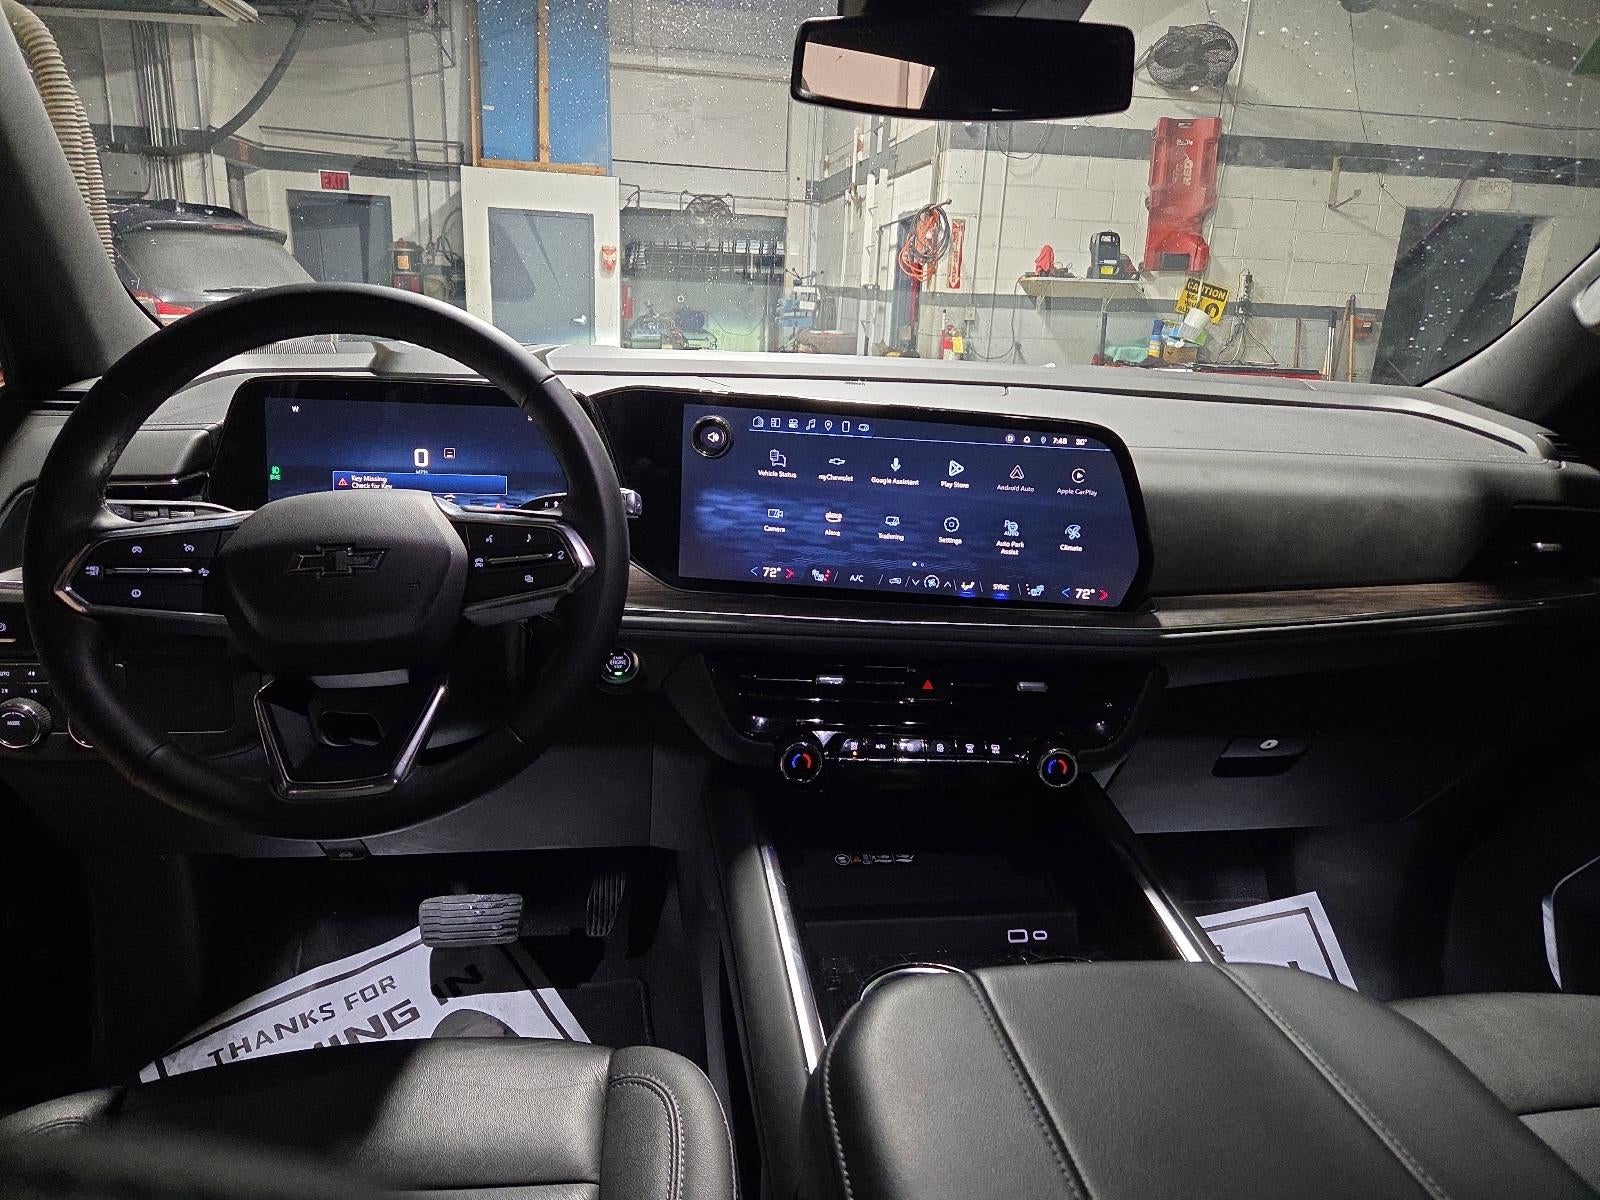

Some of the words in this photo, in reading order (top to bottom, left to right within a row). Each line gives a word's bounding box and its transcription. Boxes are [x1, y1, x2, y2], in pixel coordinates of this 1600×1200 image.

[322, 172, 348, 189] EXIT
[414, 448, 429, 467] 0
[757, 469, 778, 477] Vehicle
[778, 470, 797, 478] Status
[818, 473, 854, 482] myChevrolet
[351, 474, 363, 482] Key
[363, 475, 387, 483] Missing
[870, 476, 892, 485] Google
[892, 478, 920, 486] Assistant
[940, 480, 953, 489] Play
[953, 481, 970, 489] Store
[996, 484, 1020, 492] Android
[1020, 485, 1035, 493] Auto
[1056, 487, 1075, 495] Apple
[1074, 488, 1098, 497] CarPlay
[763, 524, 786, 533] Camera
[824, 528, 841, 537] Alexa
[938, 536, 963, 545] Settings
[996, 540, 1011, 548] Auto
[1011, 540, 1025, 548] Park
[1000, 548, 1019, 556] Assist
[1059, 543, 1083, 552] Climate
[849, 574, 864, 583] A/C
[992, 583, 1010, 591] SYNC
[430, 963, 484, 1007] IN
[207, 1001, 336, 1065] THANKS
[343, 975, 399, 1012] FOR
